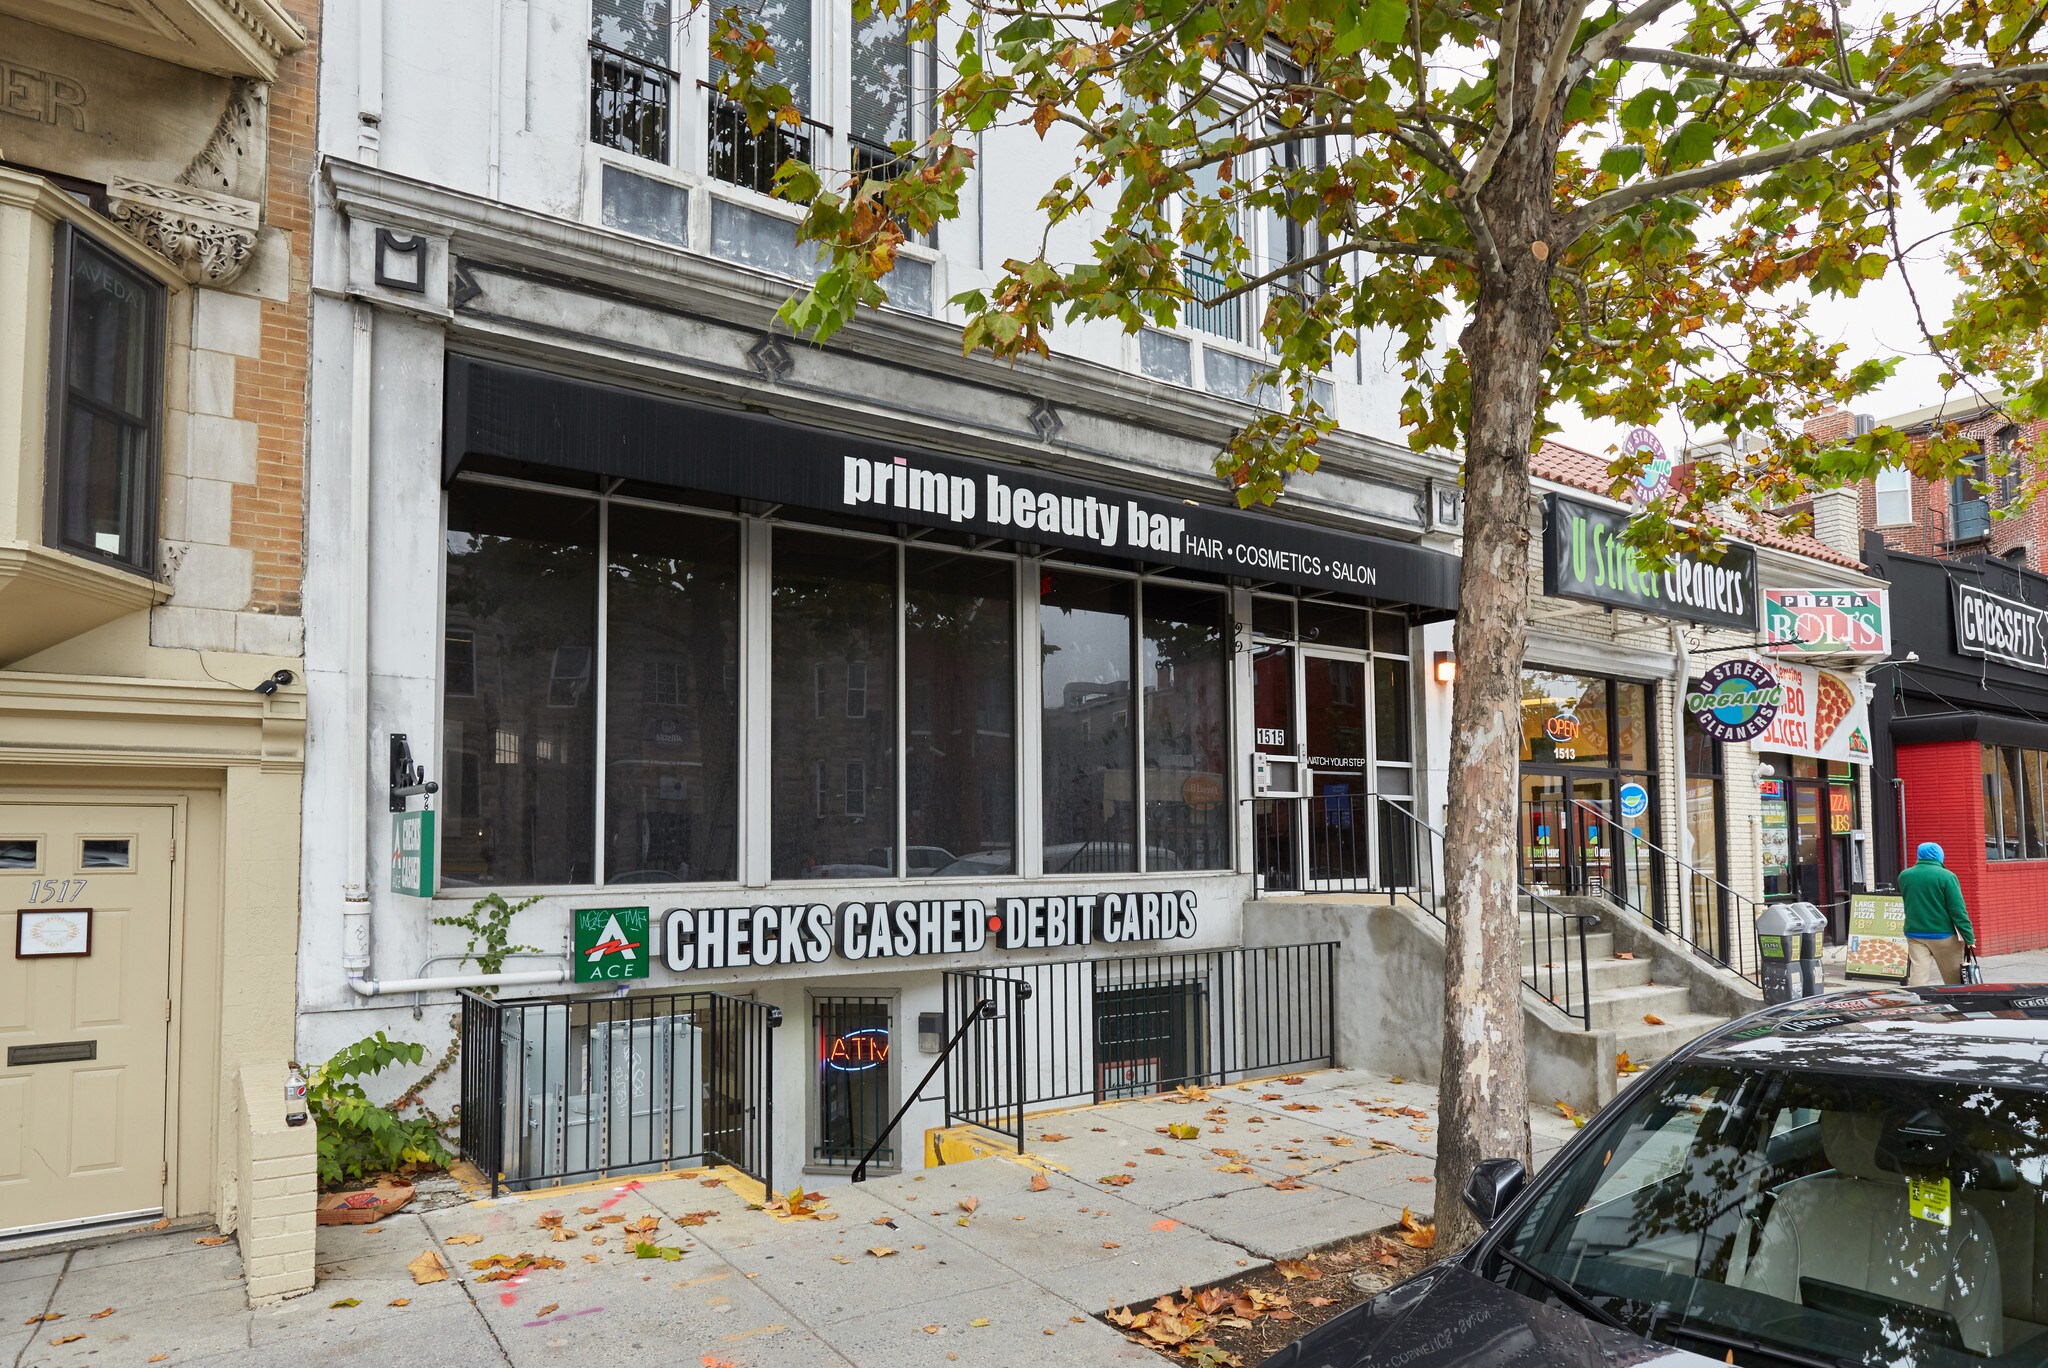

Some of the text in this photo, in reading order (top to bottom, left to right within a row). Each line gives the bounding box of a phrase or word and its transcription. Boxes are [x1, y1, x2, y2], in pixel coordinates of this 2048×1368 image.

[77, 260, 137, 308] AVEDA
[1632, 430, 1665, 456] STREET
[843, 455, 1377, 586] primp beauty bar HAIR COSMETICS SALON
[1572, 516, 1587, 584] U
[1663, 552, 1745, 616] Cleaners
[1785, 596, 1864, 607] PIZZA
[1963, 595, 2036, 657] CROSSFIT
[1700, 681, 1713, 692] U
[1713, 662, 1771, 686] STREET
[1688, 686, 1784, 712] ORGANIC
[1547, 717, 1579, 739] OPEN
[1699, 706, 1775, 740] CLEANERS
[1258, 729, 1283, 745] 1515
[1307, 757, 1366, 767] WATCH YOUR STEP
[1553, 747, 1576, 760] 1513
[1760, 781, 1779, 795] PEN
[1830, 794, 1850, 811] IZZA
[1831, 814, 1850, 832] UBS
[28, 879, 88, 904] 1517
[1853, 912, 1875, 920] PIZZA
[662, 889, 1198, 973] CHECKS CASHED DEBIT CARDS
[589, 963, 634, 980] ACE
[830, 1037, 889, 1061] ATM
